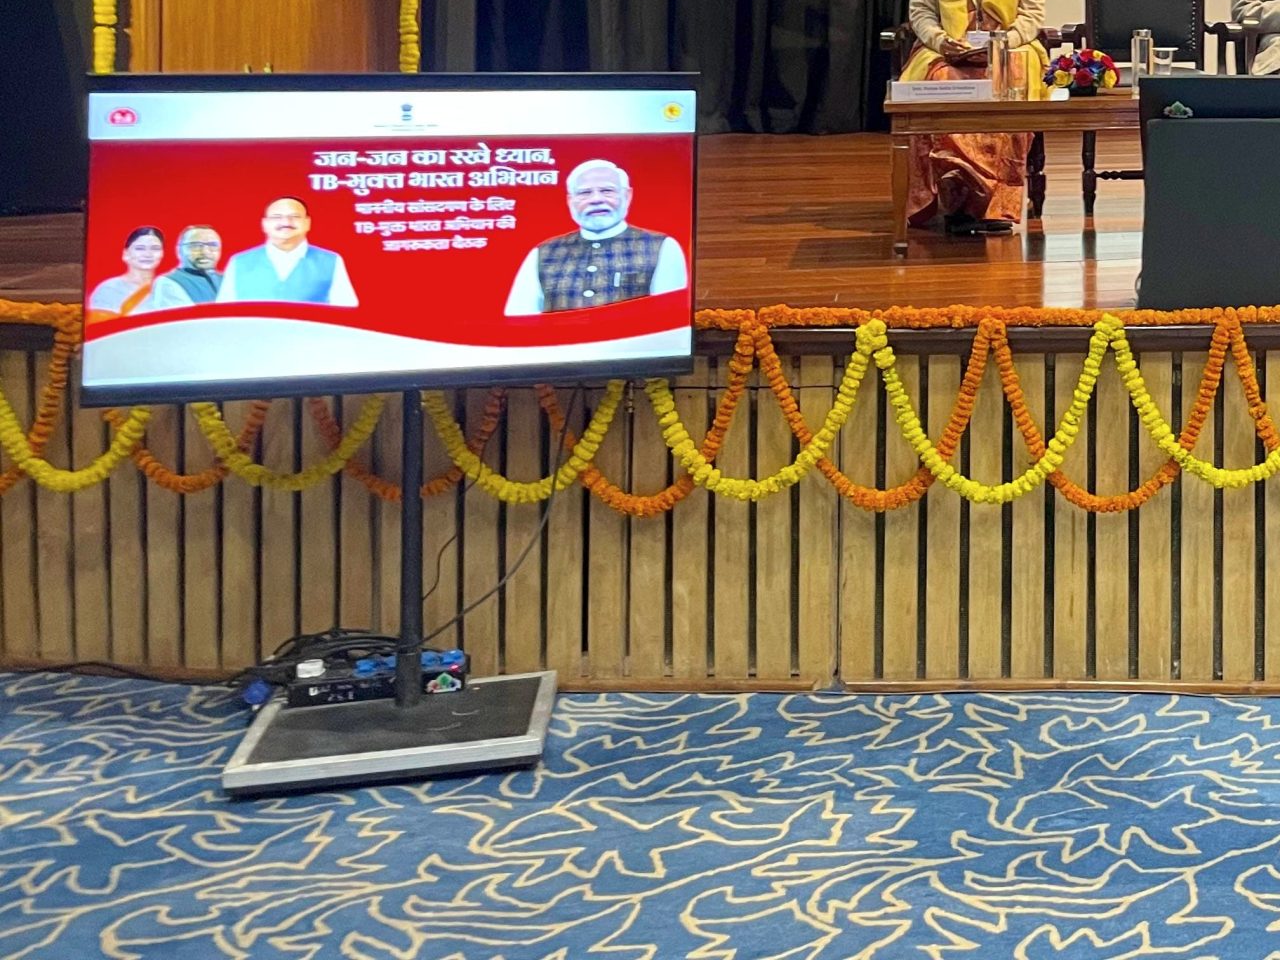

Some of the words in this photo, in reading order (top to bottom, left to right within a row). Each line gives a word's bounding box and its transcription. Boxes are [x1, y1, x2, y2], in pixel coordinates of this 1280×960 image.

[314, 150, 407, 167] जन-जन
[411, 149, 447, 166] का
[408, 171, 465, 188] भारत
[468, 165, 559, 187] अभियान
